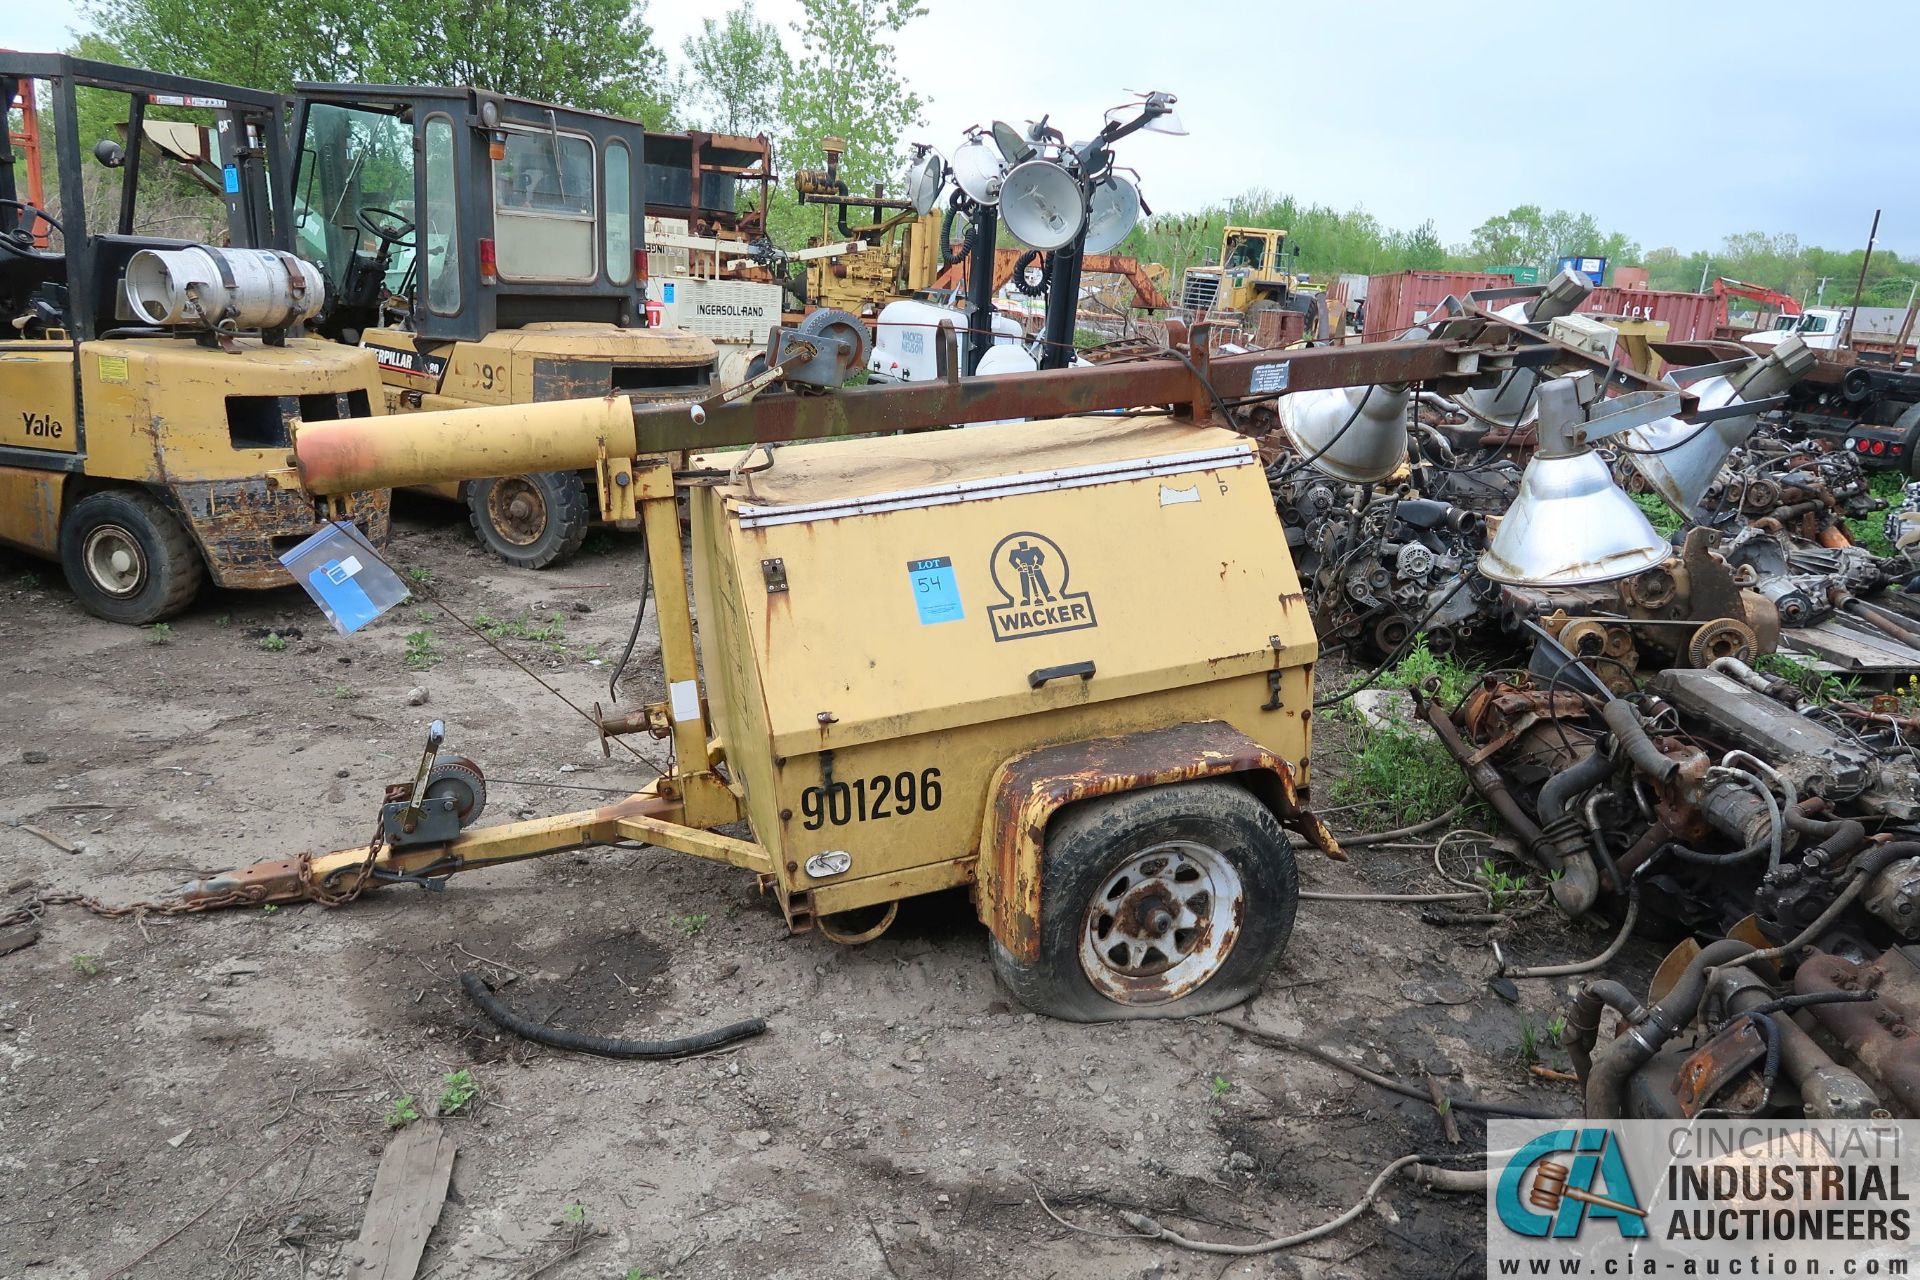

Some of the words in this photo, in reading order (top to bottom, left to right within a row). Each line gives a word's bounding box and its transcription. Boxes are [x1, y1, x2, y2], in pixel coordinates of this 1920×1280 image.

[696, 304, 764, 317] INGERSOLL-RAND
[22, 412, 63, 438] Yale
[918, 560, 940, 570] LOT
[917, 576, 942, 593] 54
[998, 603, 1087, 631] WACKER
[801, 767, 942, 831] 901296
